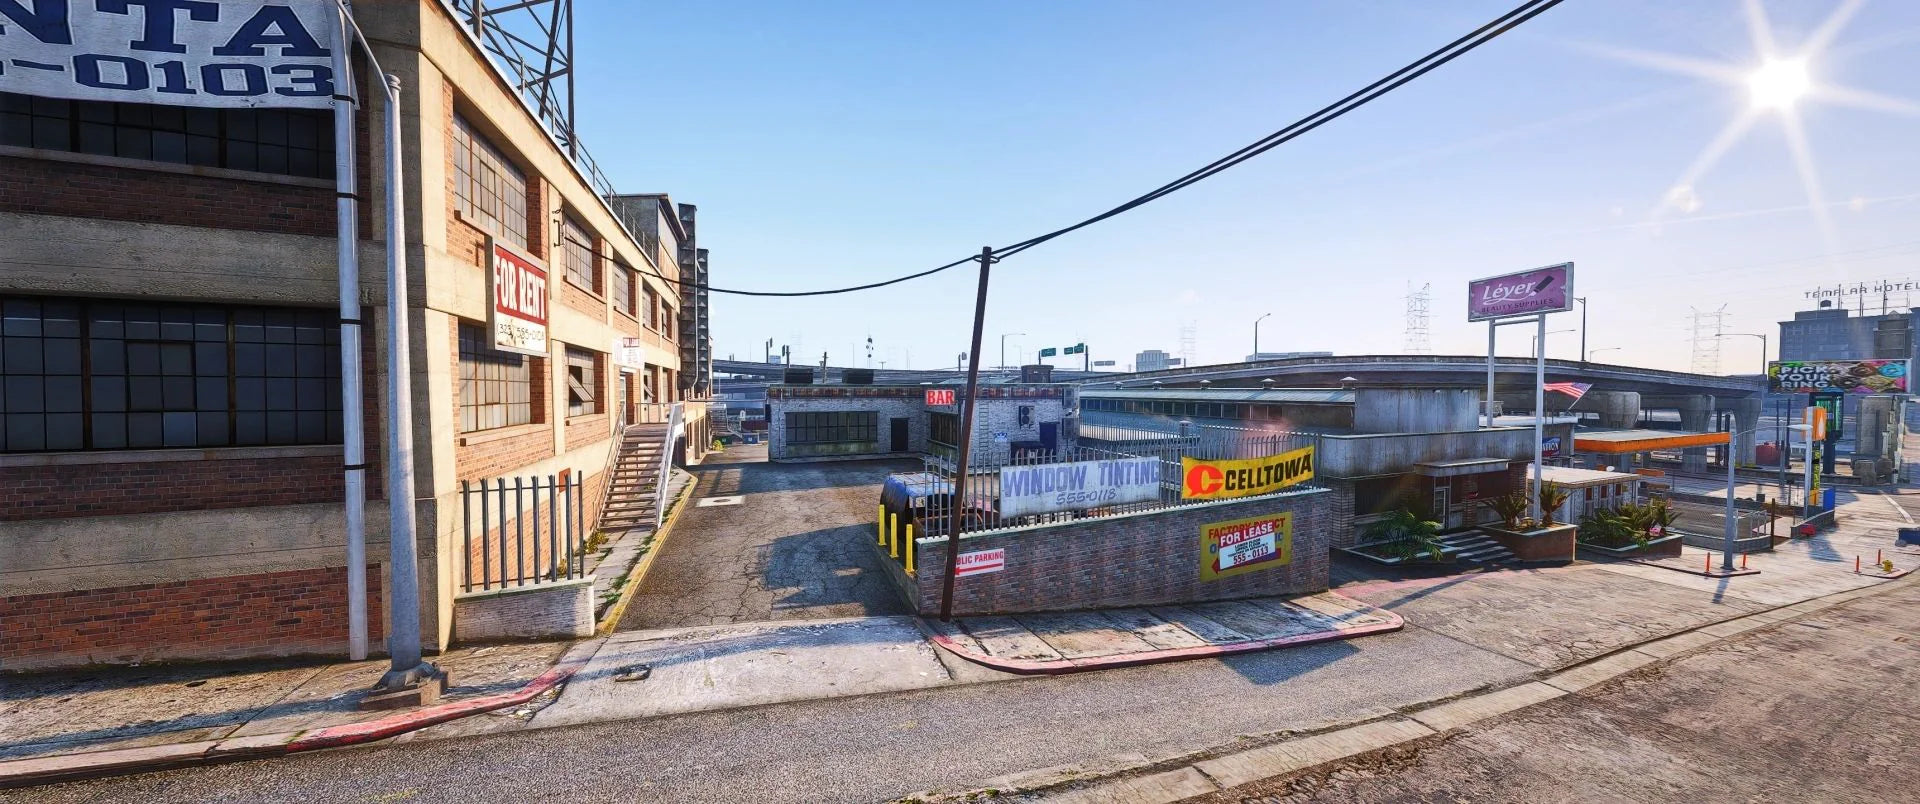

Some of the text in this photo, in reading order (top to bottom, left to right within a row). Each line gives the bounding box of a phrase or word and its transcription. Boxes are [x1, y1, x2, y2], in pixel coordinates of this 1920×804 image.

[0, 53, 334, 96] -0103
[495, 254, 545, 320] FOR RENT
[1805, 281, 1920, 298] TEMPLAR HOTEL
[1482, 297, 1553, 313] BEAUTY SUPPLIES
[1781, 365, 1829, 374] PICK
[927, 391, 954, 405] BAR
[1003, 460, 1159, 498] WINDOW TINTING
[1225, 453, 1312, 491] CELLTOWA
[1220, 531, 1240, 547] FOR
[1243, 522, 1273, 540] LEASE
[975, 551, 1003, 563] PARKING
